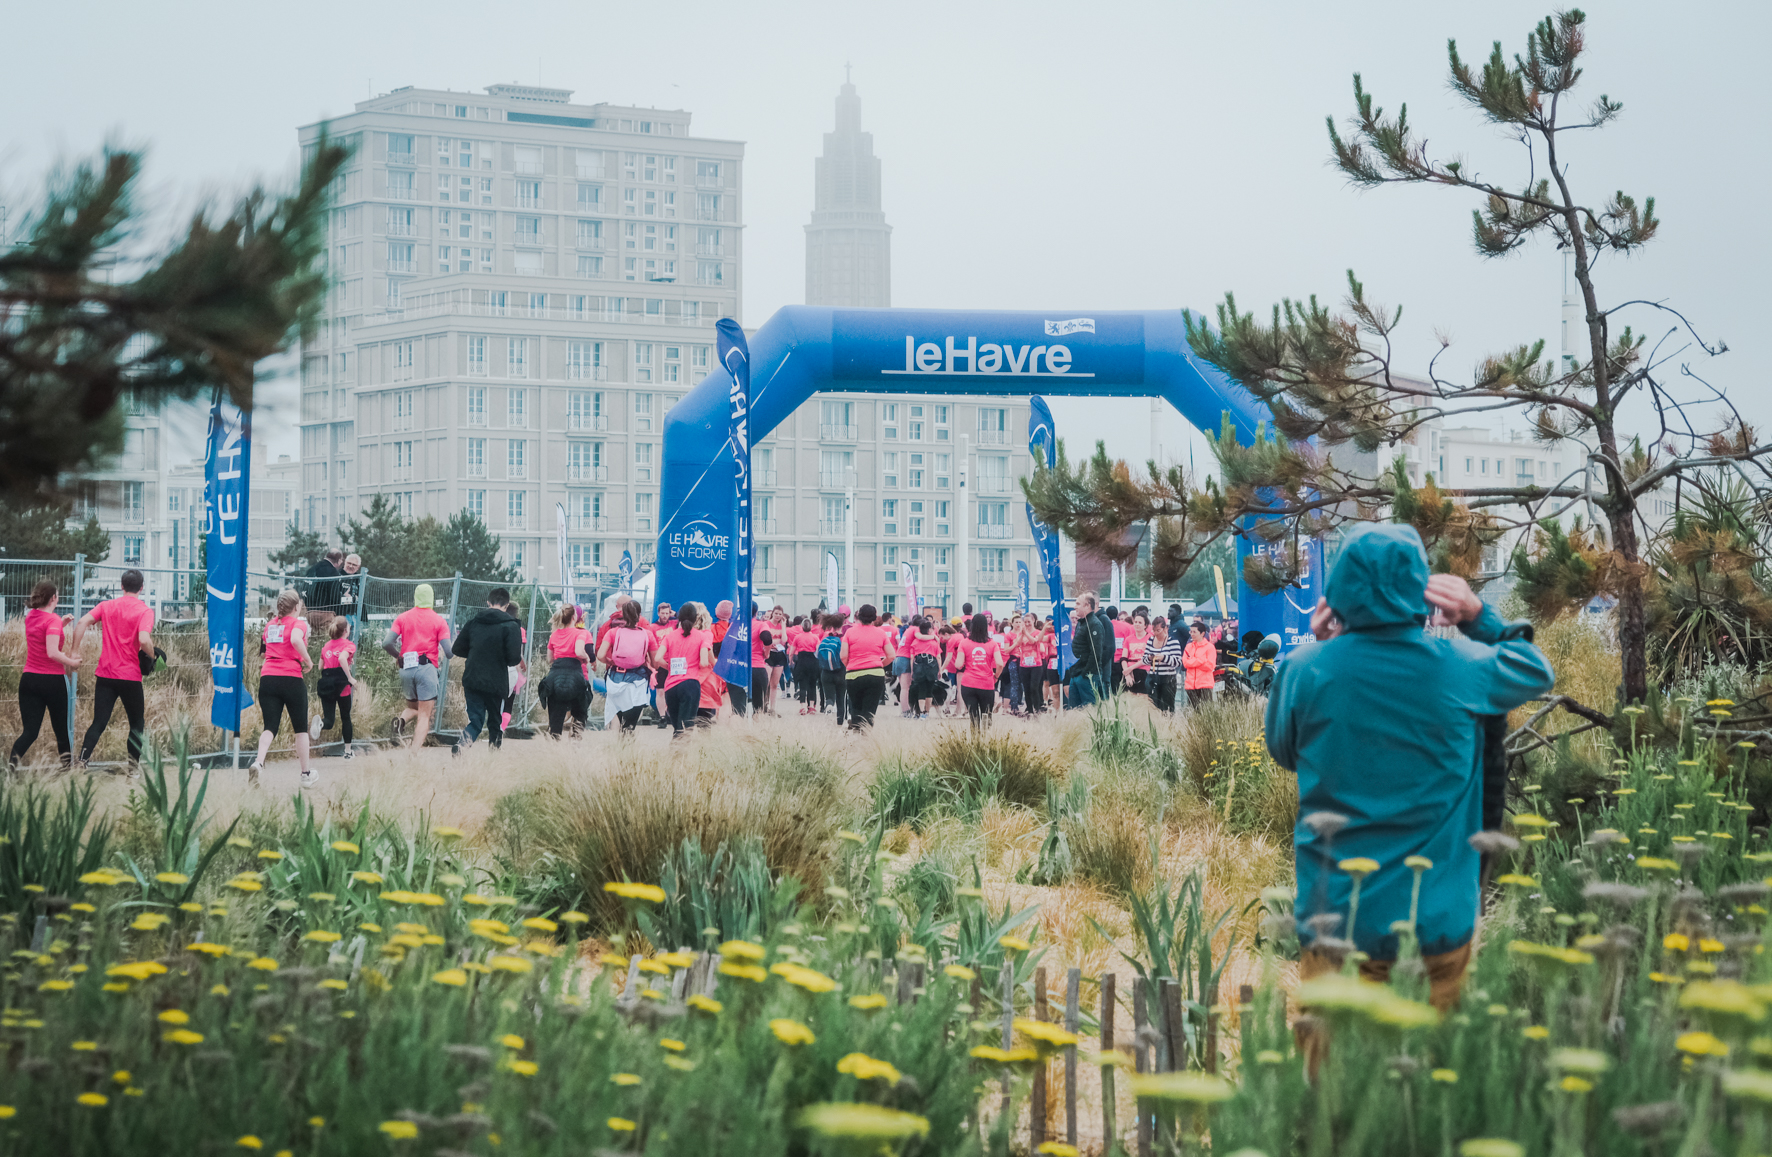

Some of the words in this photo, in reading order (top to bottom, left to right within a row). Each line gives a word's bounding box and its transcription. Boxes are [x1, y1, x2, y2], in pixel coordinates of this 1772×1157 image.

[906, 336, 1072, 373] leHavre
[669, 533, 681, 544] LE
[670, 547, 684, 557] EN
[688, 547, 727, 560] FORME
